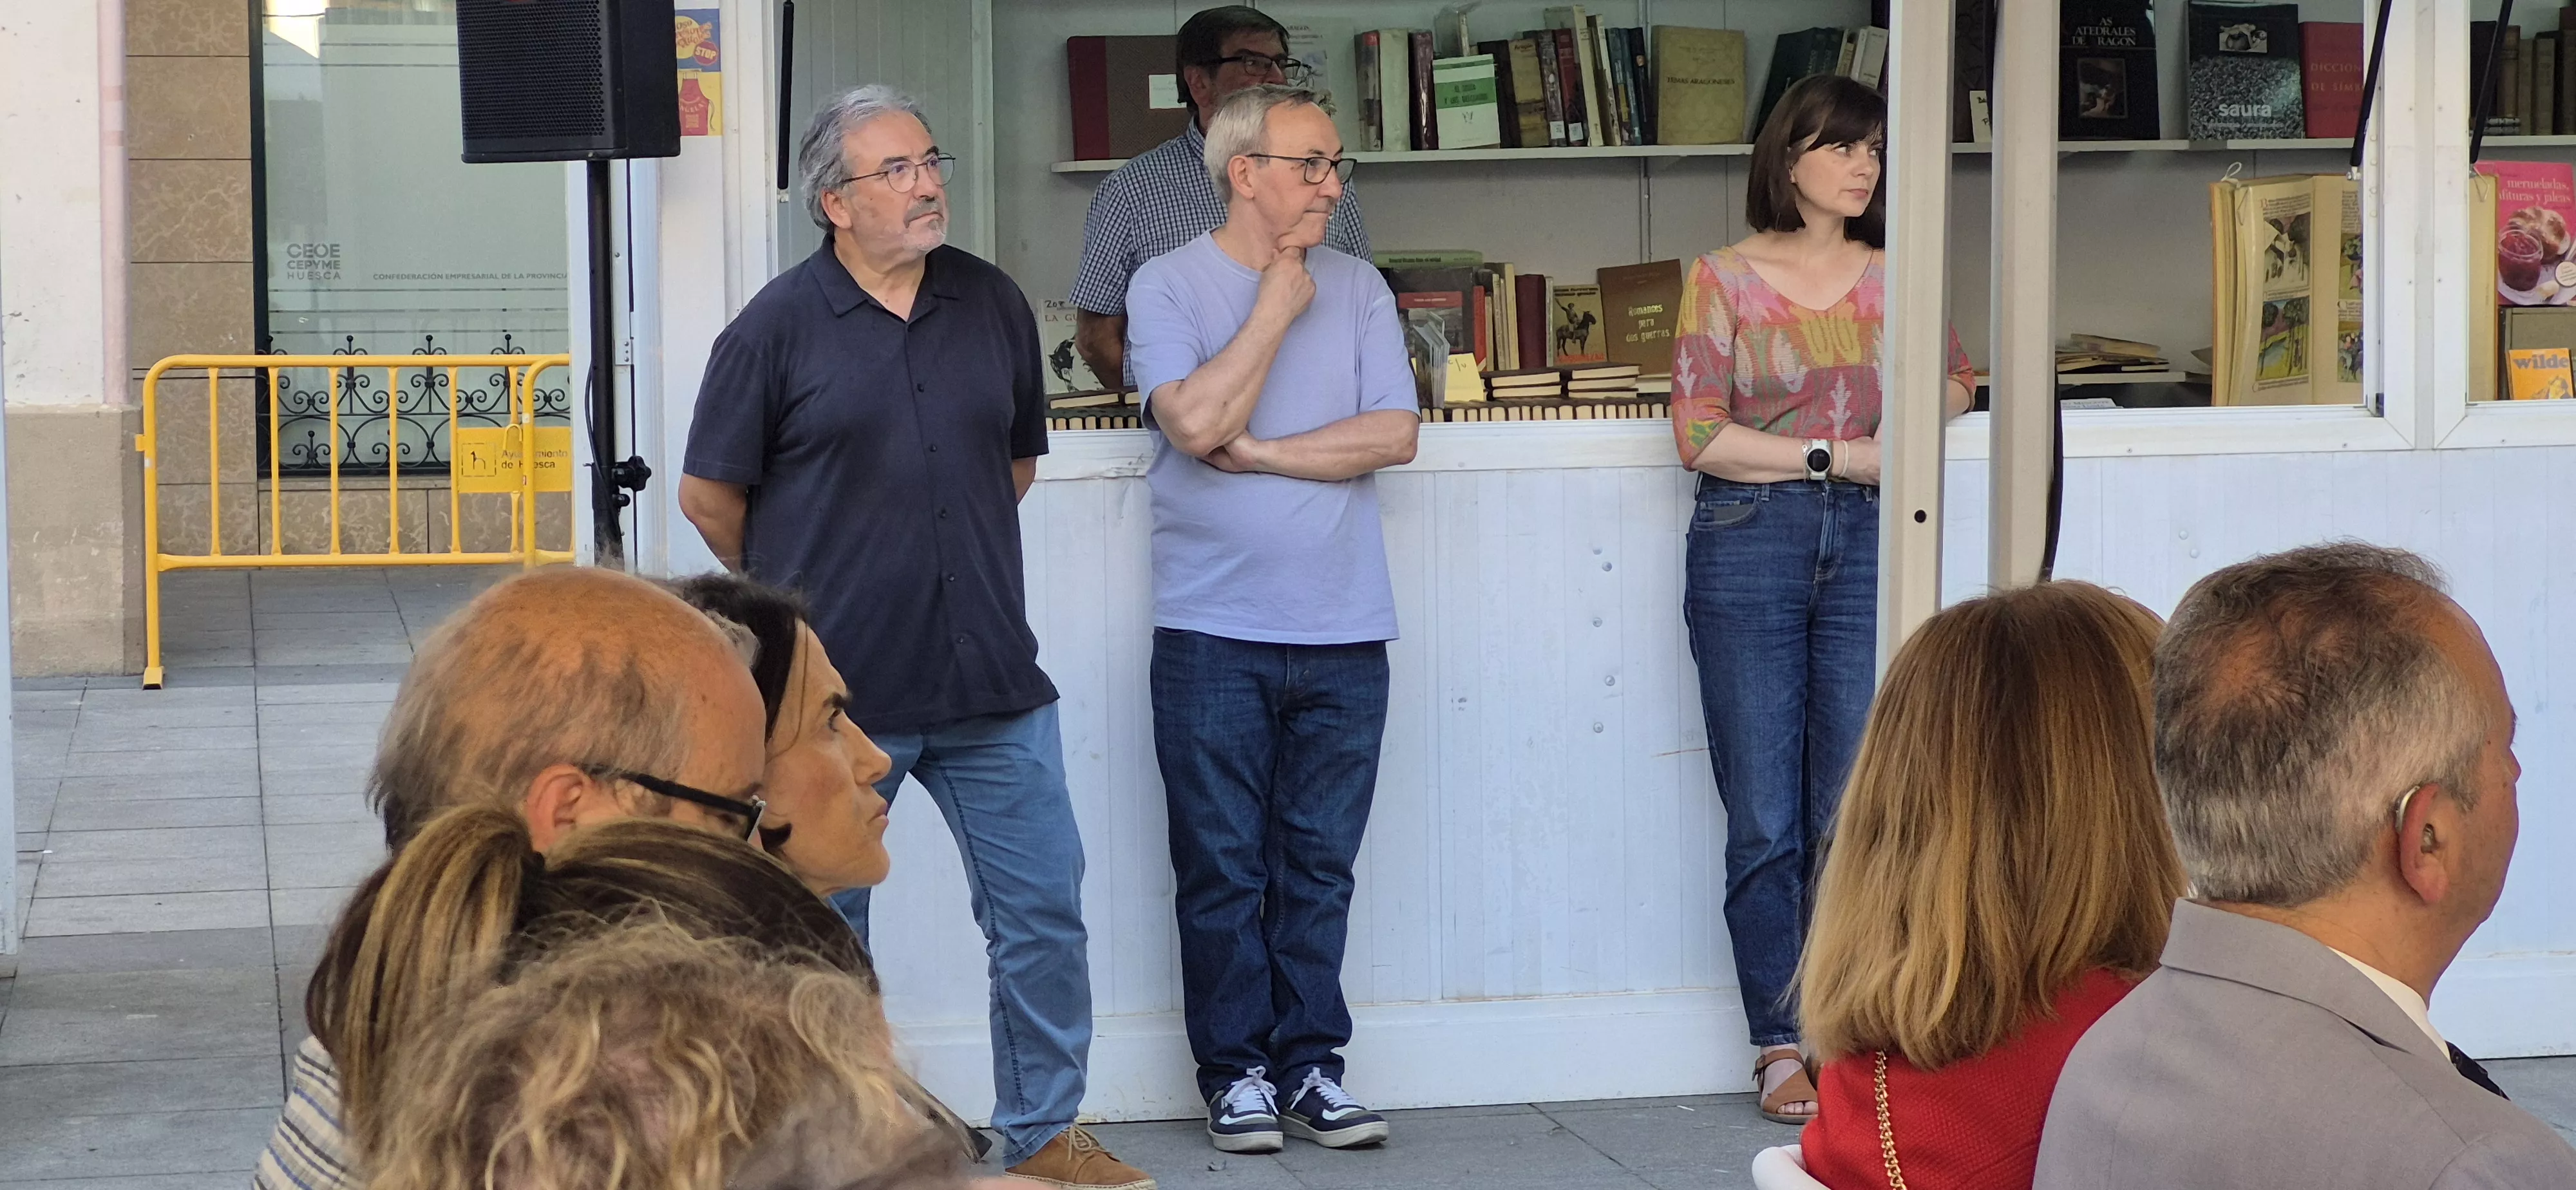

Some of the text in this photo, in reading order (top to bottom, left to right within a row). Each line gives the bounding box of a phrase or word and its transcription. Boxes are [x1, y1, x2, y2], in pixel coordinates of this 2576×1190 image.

[2072, 36, 2087, 45] DE
[695, 46, 717, 60] STOP
[2311, 82, 2325, 91] DE
[2219, 103, 2272, 117] saura
[287, 243, 341, 258] CEOE
[287, 260, 341, 270] CEPYME
[287, 271, 341, 280] HUESCA
[373, 272, 444, 281] CONFEDERACIÓN
[2513, 354, 2570, 369] wilde
[502, 449, 568, 460] Ayumiento
[501, 460, 556, 469] de Hesca
